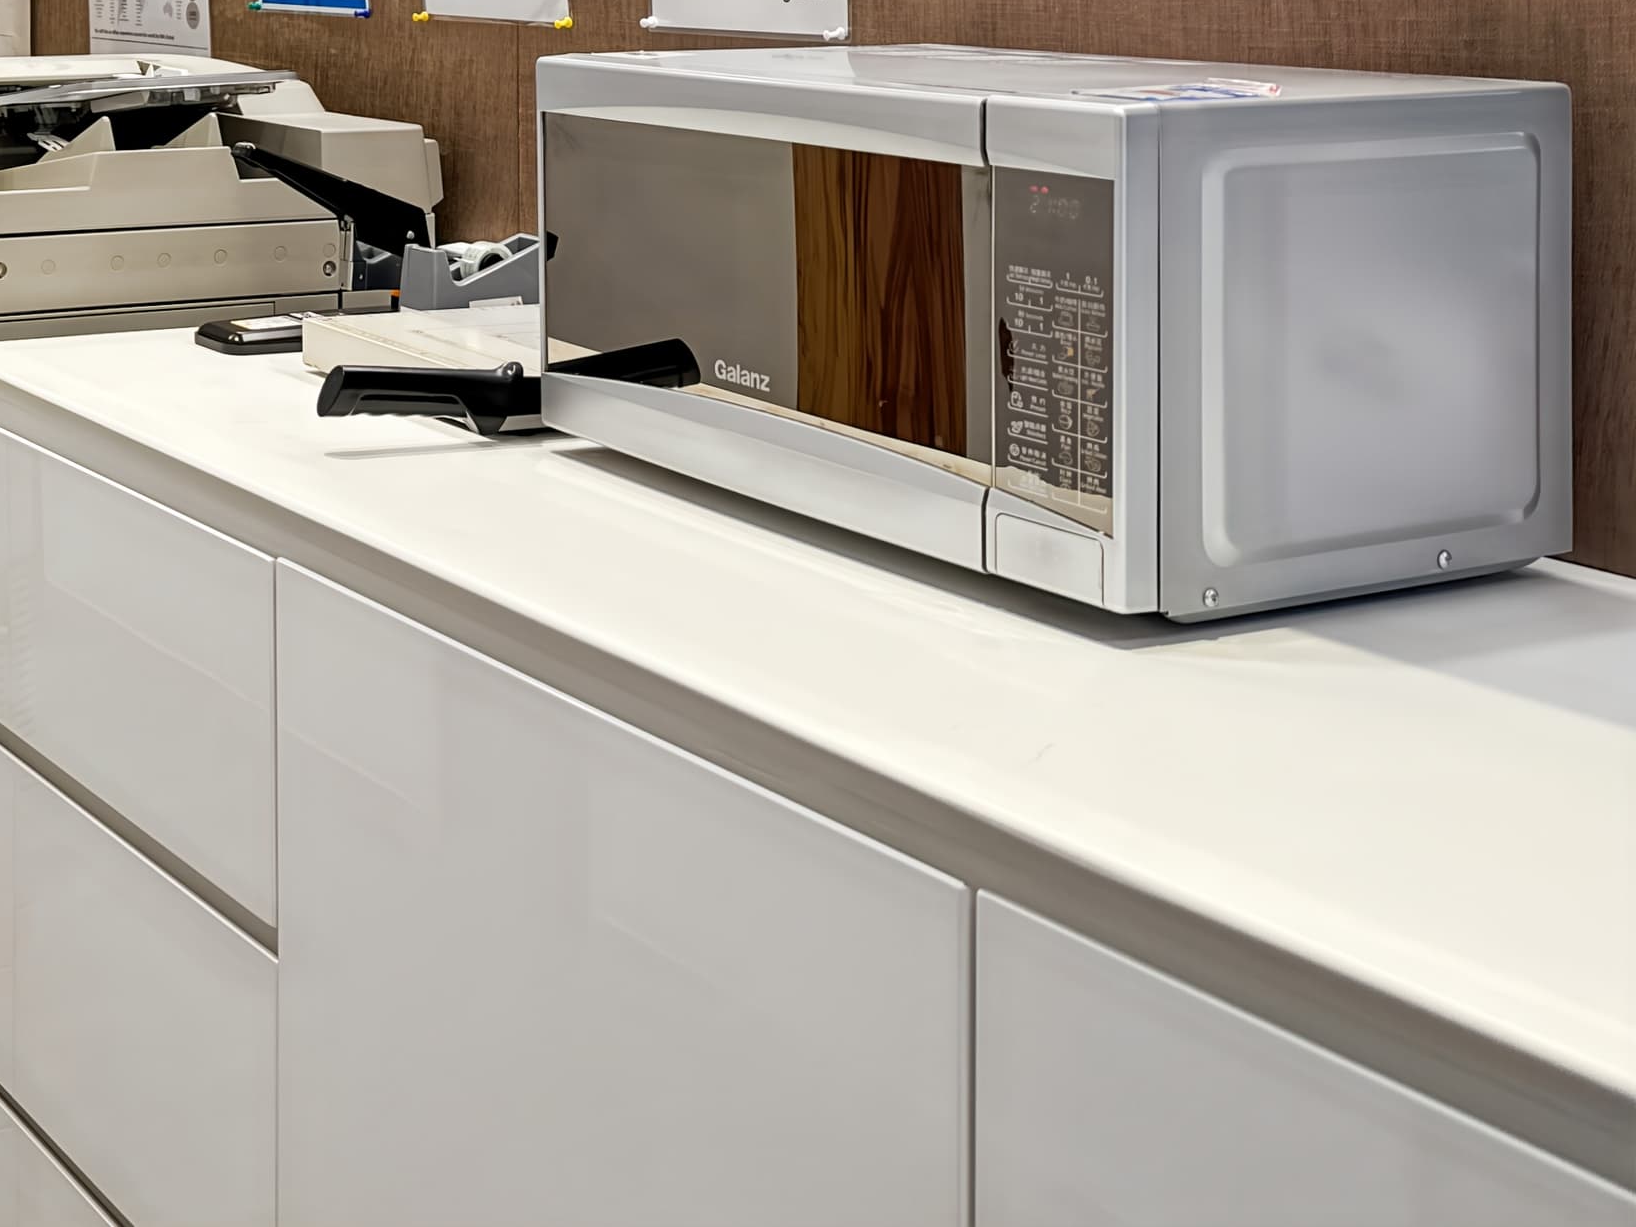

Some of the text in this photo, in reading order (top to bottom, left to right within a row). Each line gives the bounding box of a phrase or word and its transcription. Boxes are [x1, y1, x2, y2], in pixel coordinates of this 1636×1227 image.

[1014, 292, 1024, 301] 10
[1014, 318, 1024, 327] 10
[714, 359, 770, 392] Galanz
